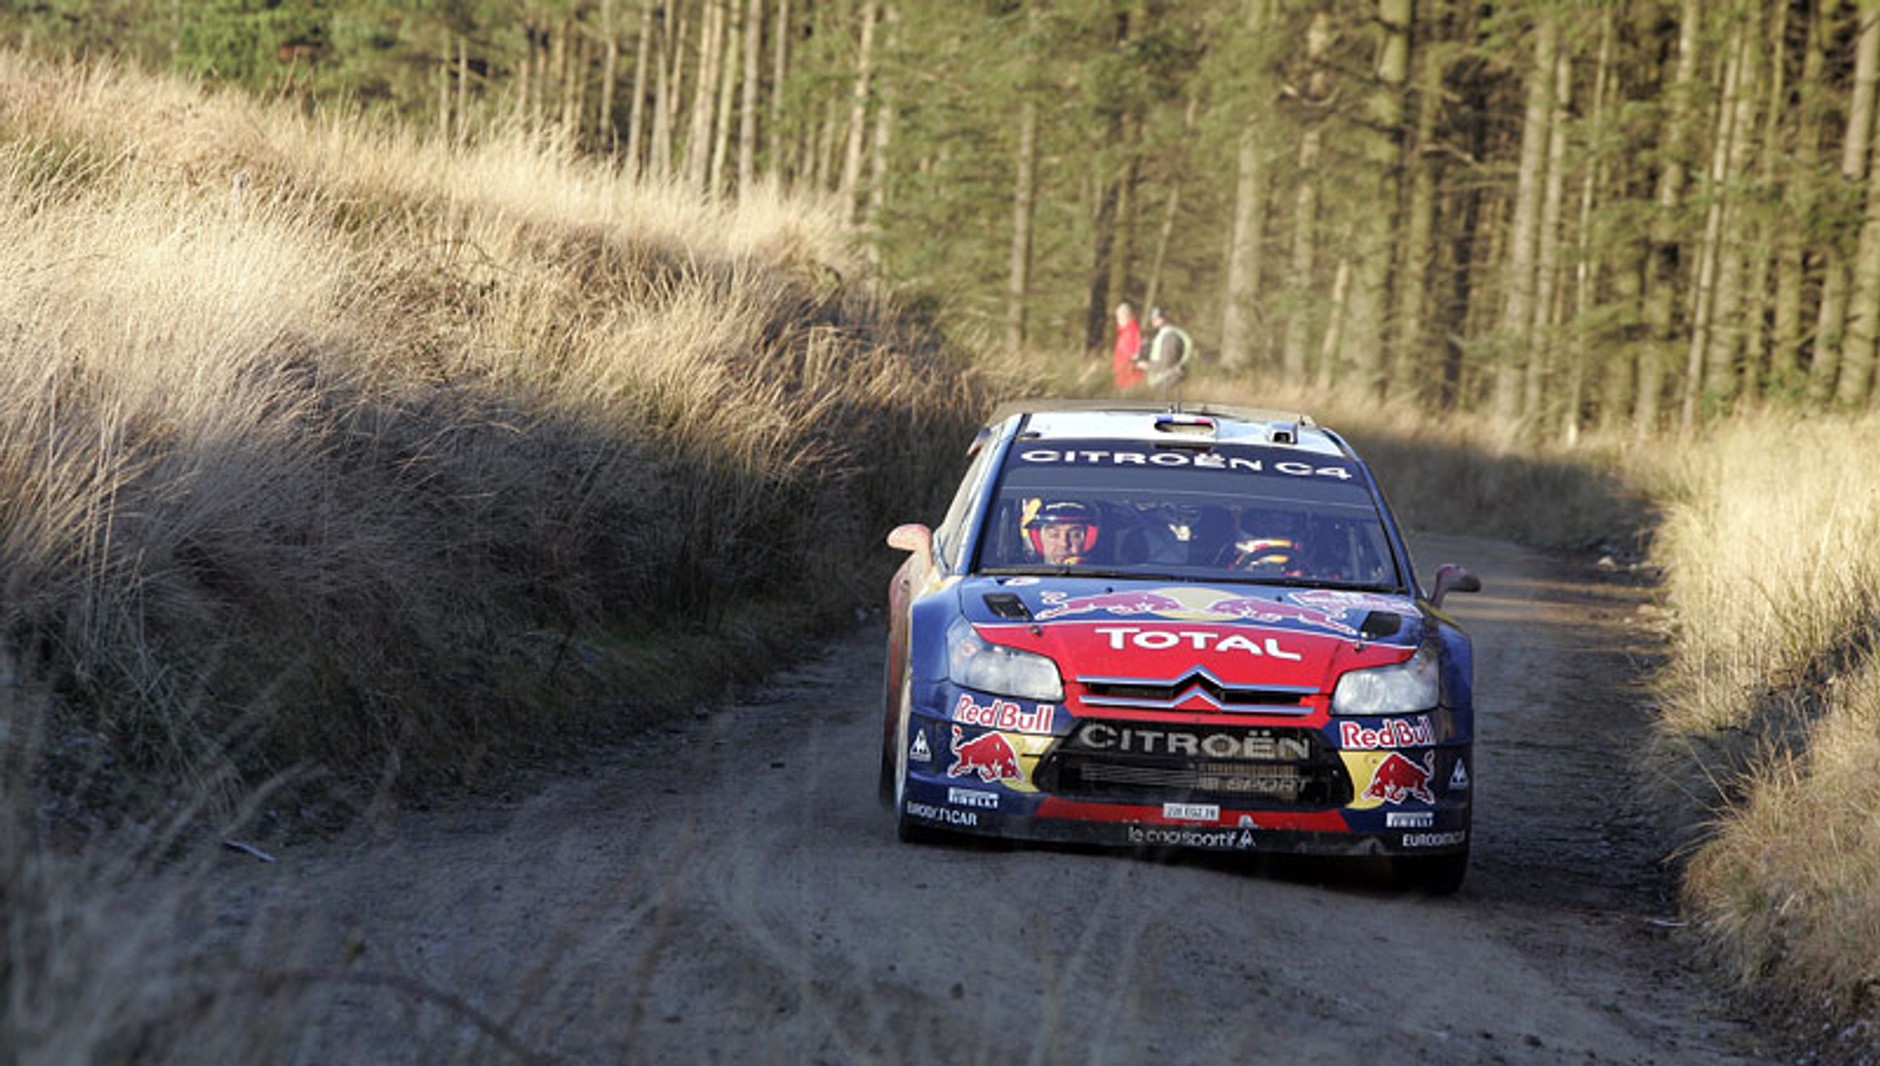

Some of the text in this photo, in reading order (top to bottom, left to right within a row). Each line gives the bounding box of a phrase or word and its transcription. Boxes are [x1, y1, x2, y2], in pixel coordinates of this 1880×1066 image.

[1020, 449, 1352, 480] CITROËN C4
[1094, 627, 1302, 661] TOTAL
[952, 693, 1055, 733] Red Bull
[1079, 724, 1311, 760] CITROËN
[1340, 715, 1436, 749] Red Bull
